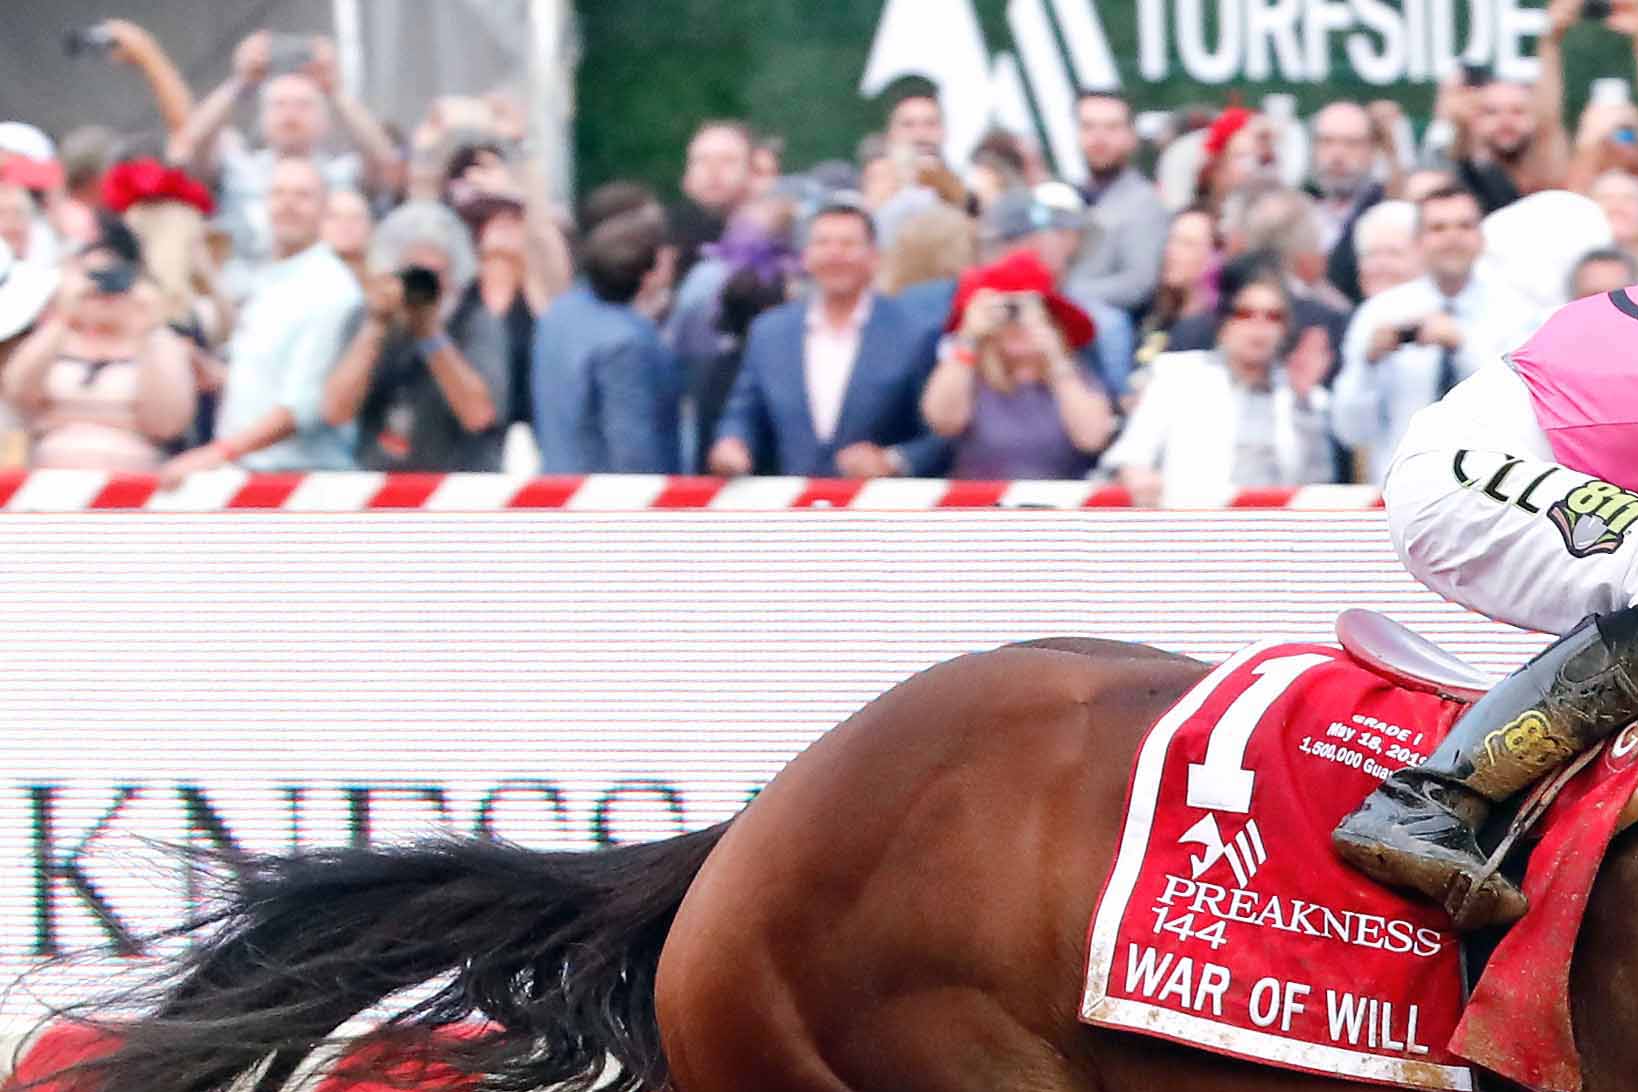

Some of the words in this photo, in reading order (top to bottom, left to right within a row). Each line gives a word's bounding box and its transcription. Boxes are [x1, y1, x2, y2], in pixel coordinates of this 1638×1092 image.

[1186, 652, 1338, 814] 1
[1326, 722, 1356, 742] May
[1357, 732, 1384, 754] 18,
[1352, 714, 1412, 741] GRADE
[1299, 736, 1363, 769] 1,500,000
[1152, 906, 1229, 951] 144
[1156, 874, 1441, 957] PREAKNESS
[1124, 943, 1231, 1016] WAR
[1248, 976, 1311, 1032] OF
[1326, 989, 1430, 1055] WILL
